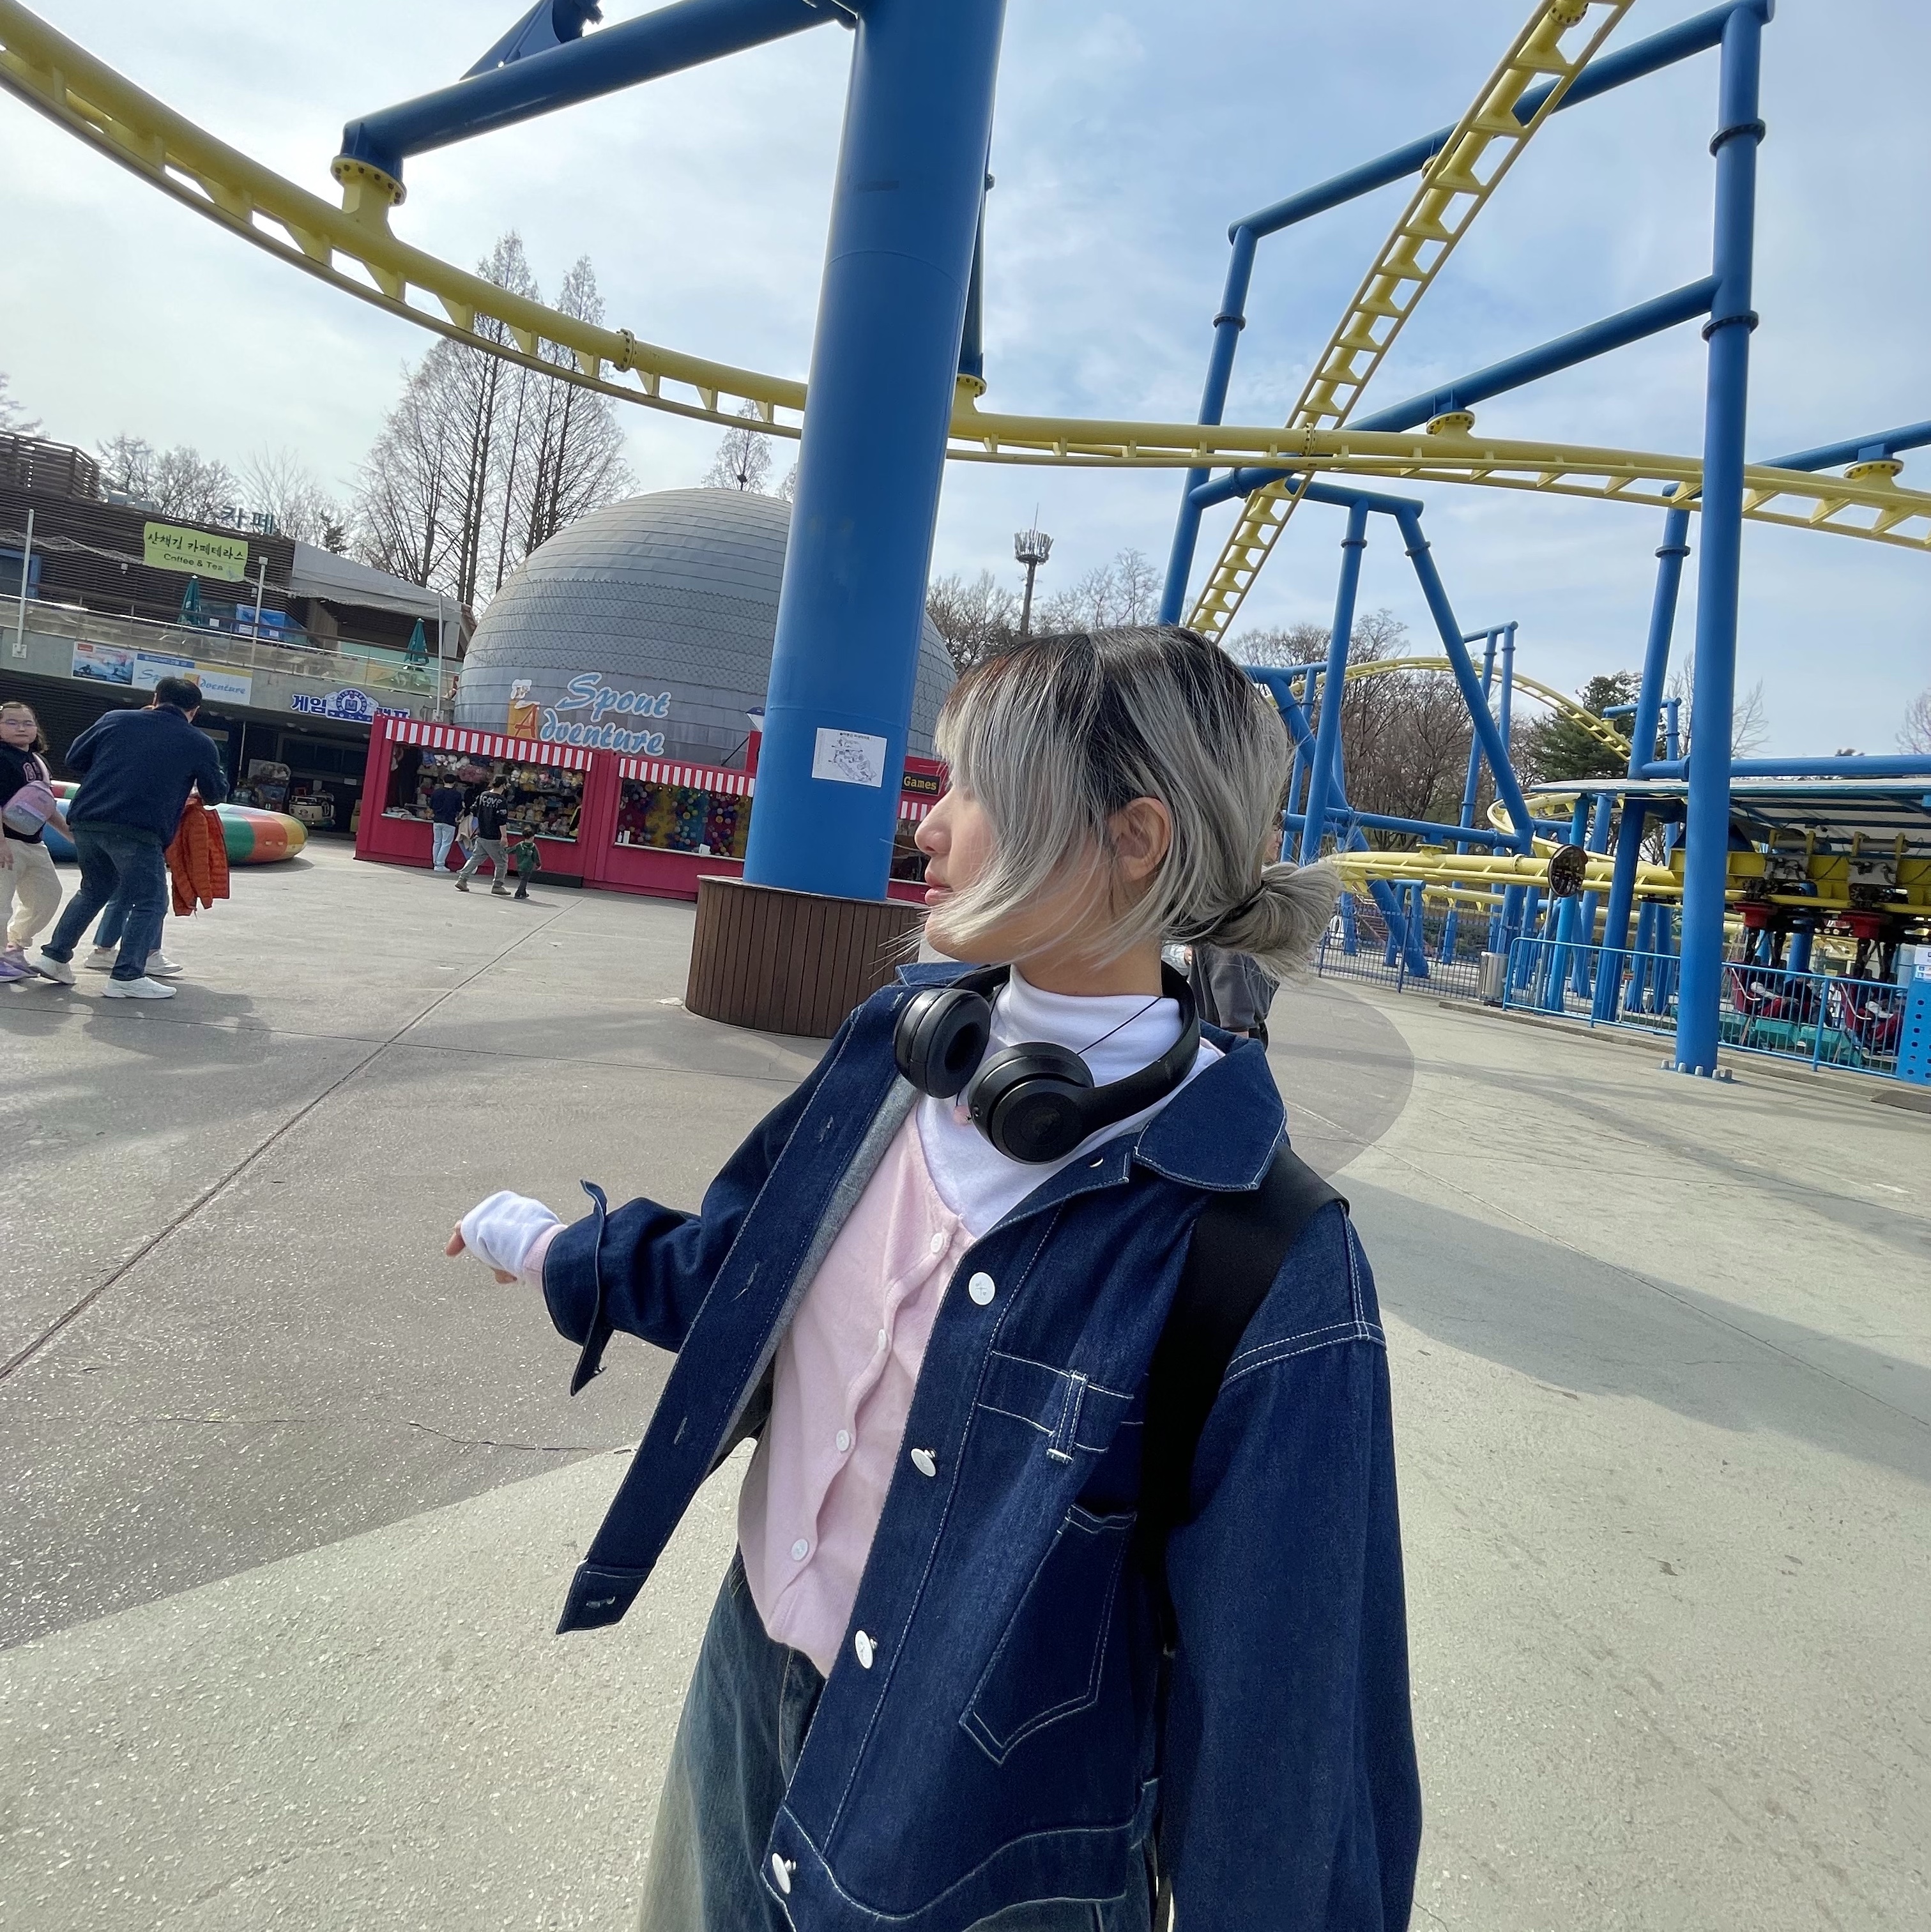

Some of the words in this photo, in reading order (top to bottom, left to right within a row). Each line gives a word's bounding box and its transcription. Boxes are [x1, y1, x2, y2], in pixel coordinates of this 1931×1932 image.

[221, 506, 275, 535] 카페
[148, 532, 183, 550] 산책길
[188, 540, 245, 561] 카페테라스
[164, 553, 194, 565] Coffee
[197, 559, 203, 567] &
[206, 561, 224, 571] Tea
[292, 695, 327, 713] 게임
[554, 673, 671, 722] Spout
[903, 776, 937, 791] Games
